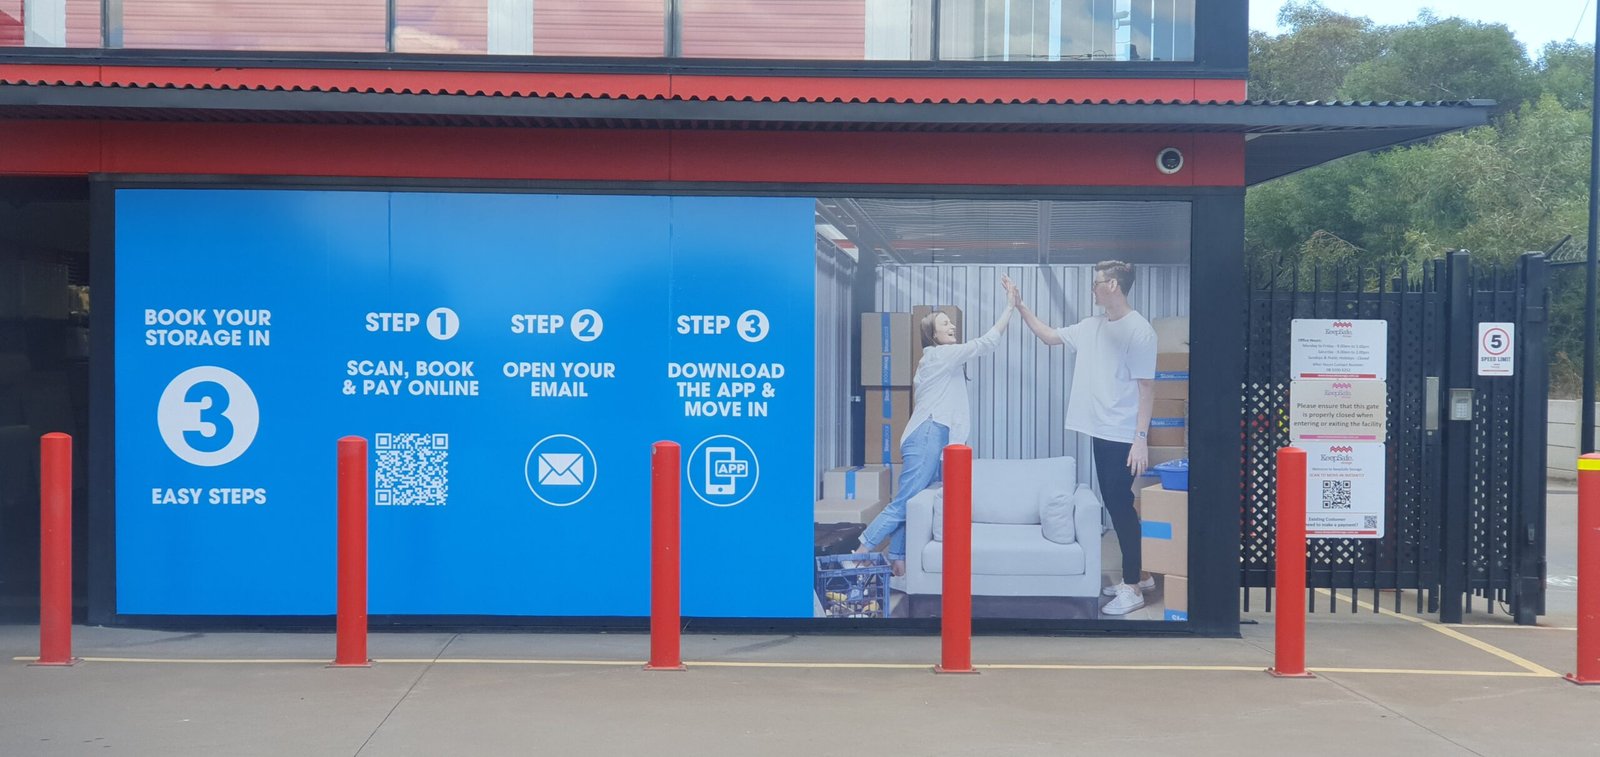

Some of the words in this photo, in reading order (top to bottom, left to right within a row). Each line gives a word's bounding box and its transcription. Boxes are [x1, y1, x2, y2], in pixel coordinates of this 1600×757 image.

[144, 308, 207, 326] BOOK
[212, 309, 272, 326] YOUR
[365, 312, 420, 332] STEP
[436, 312, 447, 335] 1
[510, 313, 565, 334] STEP
[578, 313, 596, 337] 2
[676, 315, 731, 335] STEP
[744, 314, 762, 338] 3
[145, 329, 242, 346] STORAGE
[248, 330, 270, 346] IN
[1490, 334, 1502, 349] 5
[346, 360, 409, 378] SCAN,
[416, 360, 474, 377] BOOK
[502, 362, 558, 378] OPEN
[561, 362, 616, 378] YOUR
[668, 362, 785, 379] DOWNLOAD
[342, 379, 356, 395] &
[363, 380, 402, 395] PAY
[408, 380, 479, 396] ONLINE
[530, 381, 588, 397] EMAIL
[676, 382, 711, 398] THE
[716, 382, 756, 398] APP
[761, 382, 776, 398] &
[182, 380, 235, 453] 3
[684, 401, 742, 417] MOVE
[747, 401, 768, 417] IN
[718, 463, 746, 474] APP
[151, 487, 203, 505] EASY
[208, 487, 267, 505] STEPS
